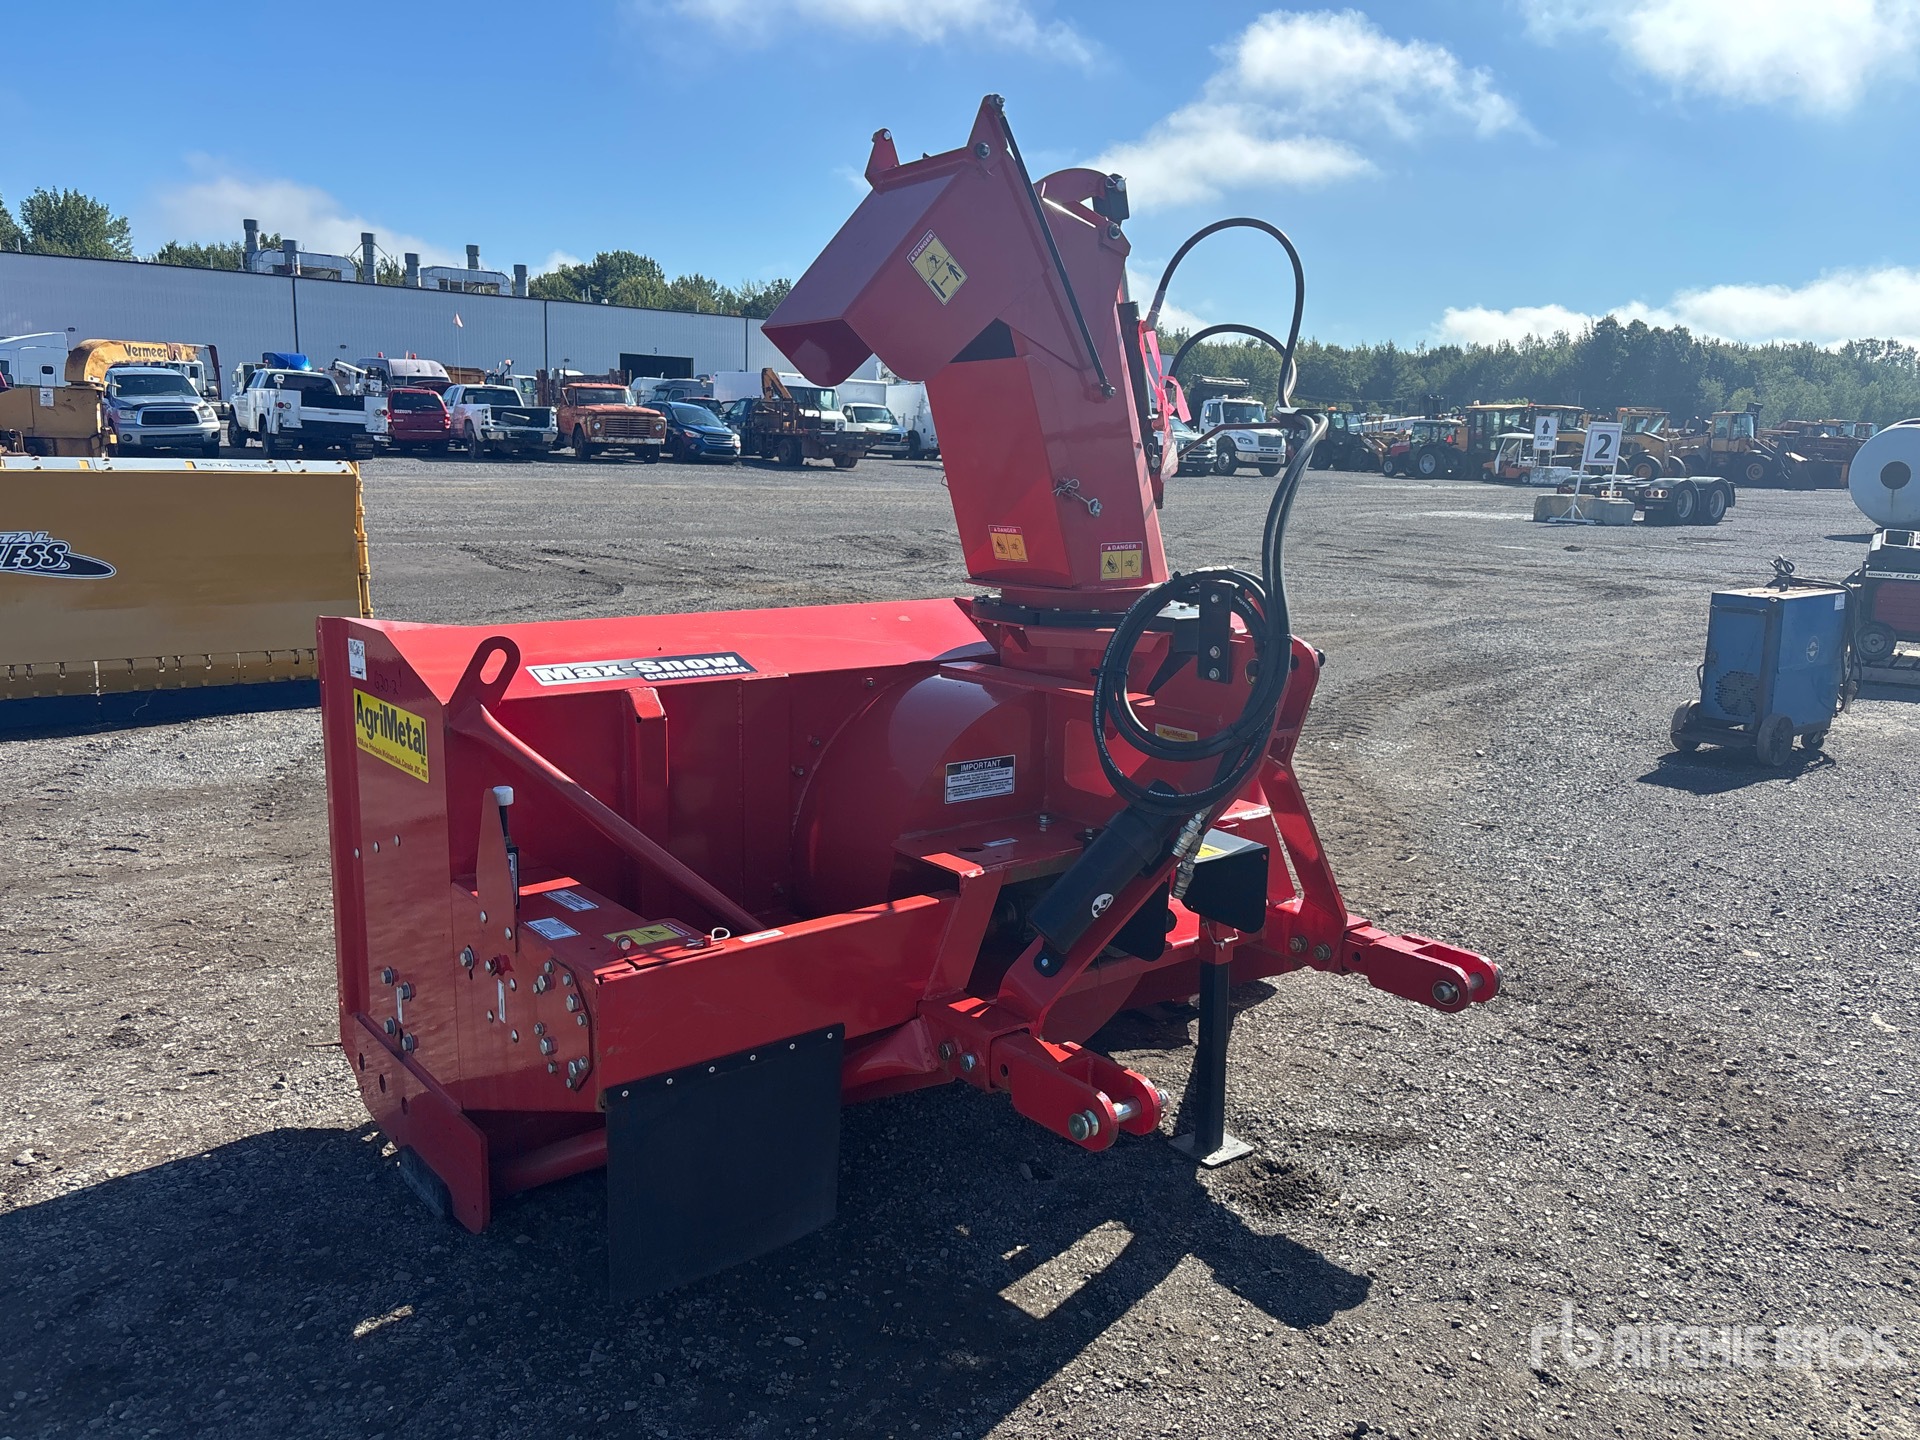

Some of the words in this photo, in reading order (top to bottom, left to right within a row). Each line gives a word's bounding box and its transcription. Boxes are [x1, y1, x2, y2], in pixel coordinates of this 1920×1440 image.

[914, 233, 934, 257] DANGER
[123, 344, 166, 357] Vermeer
[653, 346, 658, 355] 3
[1594, 433, 1612, 459] 2
[1112, 543, 1137, 551] DANGER
[534, 656, 739, 681] Max-Snow
[644, 666, 750, 681] COMMERCIAL
[356, 694, 427, 756] AgriMetal
[960, 760, 1001, 772] IMPORTANT
